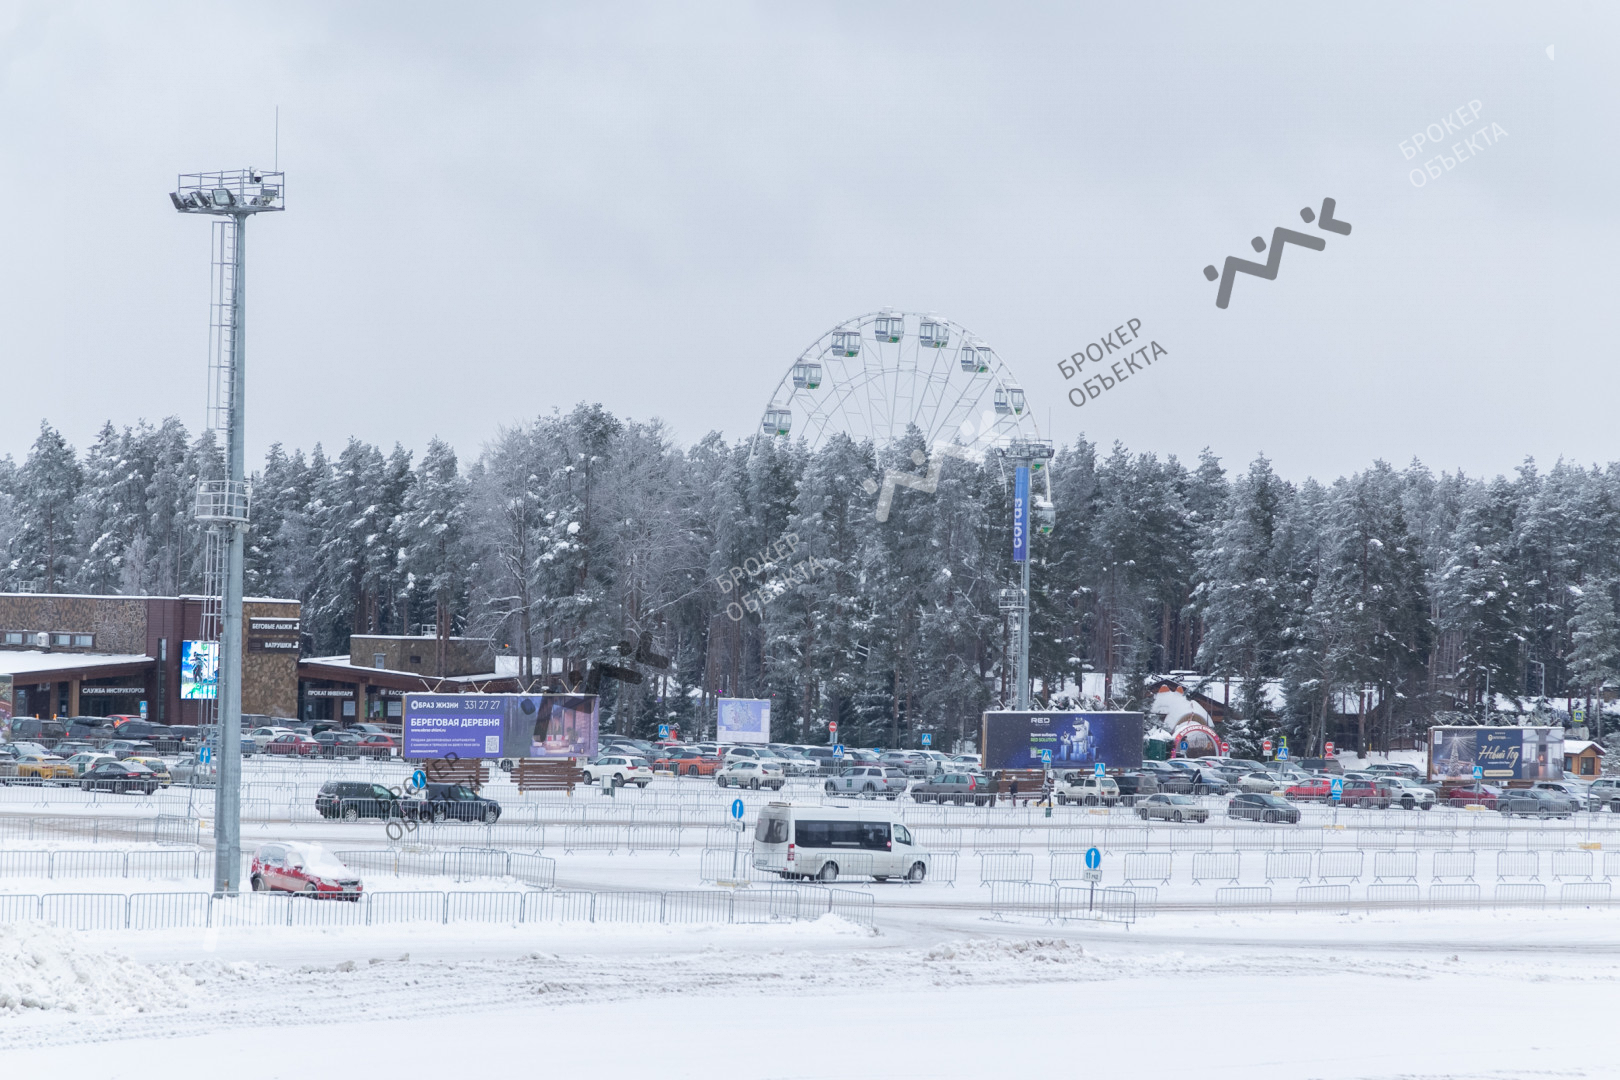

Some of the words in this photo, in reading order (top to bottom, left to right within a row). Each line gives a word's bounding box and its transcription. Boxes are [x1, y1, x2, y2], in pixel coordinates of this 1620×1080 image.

[436, 701, 459, 709] ЖИЗНИ
[463, 700, 477, 710] 331
[478, 700, 489, 710] 27
[490, 700, 501, 710] 27
[411, 718, 460, 727] БЕРЕГОВАЯ
[461, 718, 500, 728] ДЕРЕВНЯ
